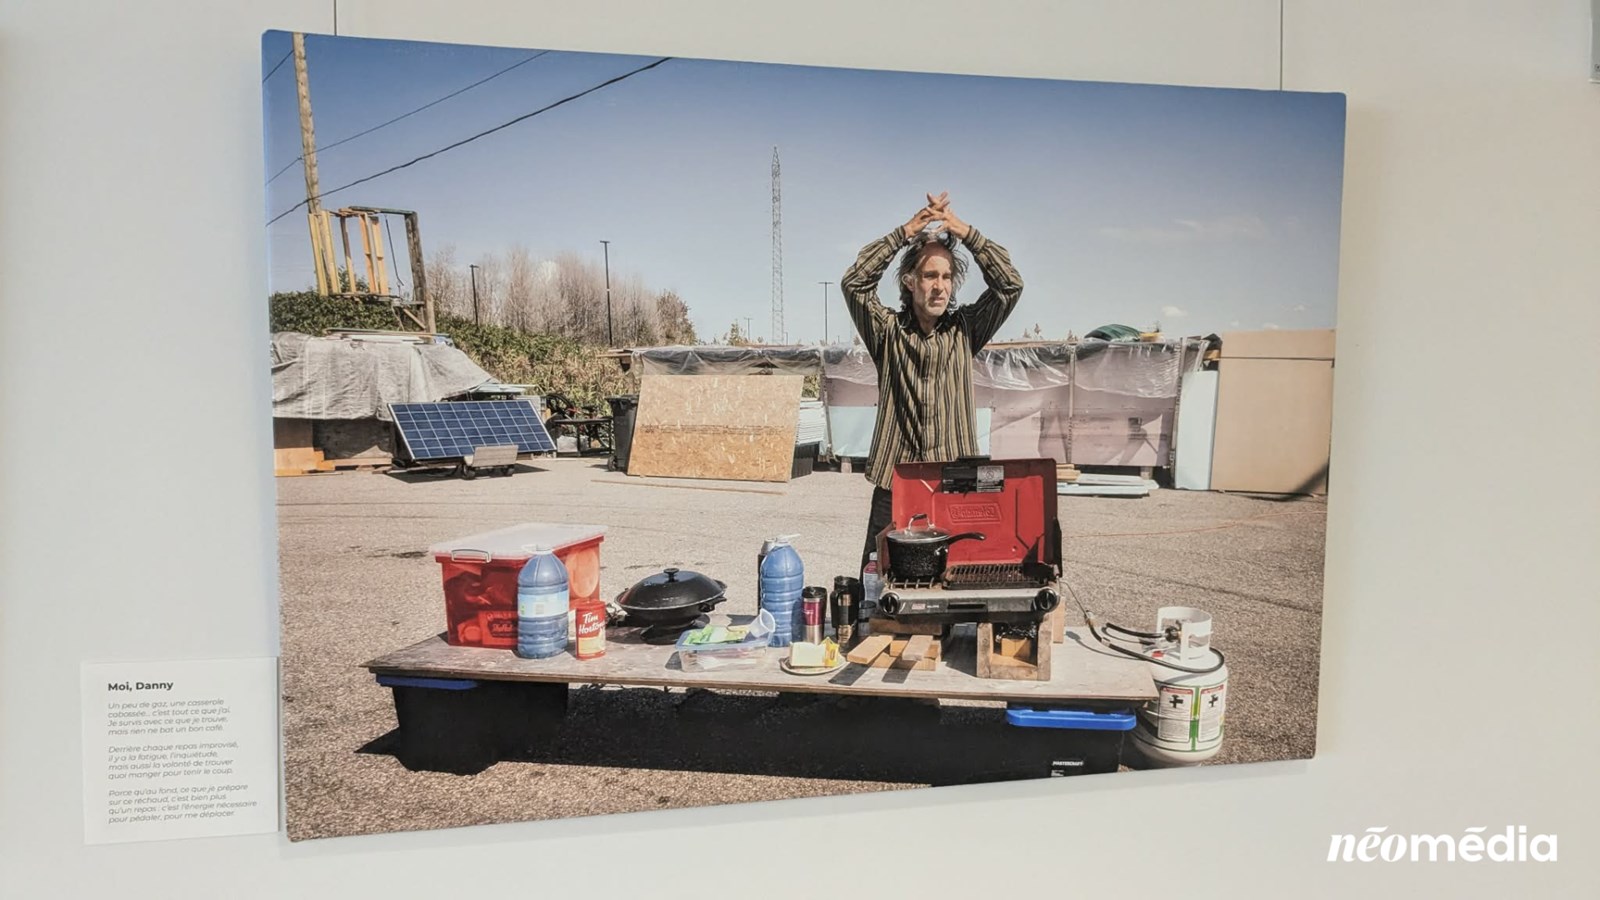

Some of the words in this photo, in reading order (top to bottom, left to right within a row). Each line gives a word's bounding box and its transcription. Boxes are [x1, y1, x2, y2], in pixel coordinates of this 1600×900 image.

[582, 611, 598, 624] Tim
[108, 682, 132, 692] Moi,
[136, 682, 174, 691] Danny
